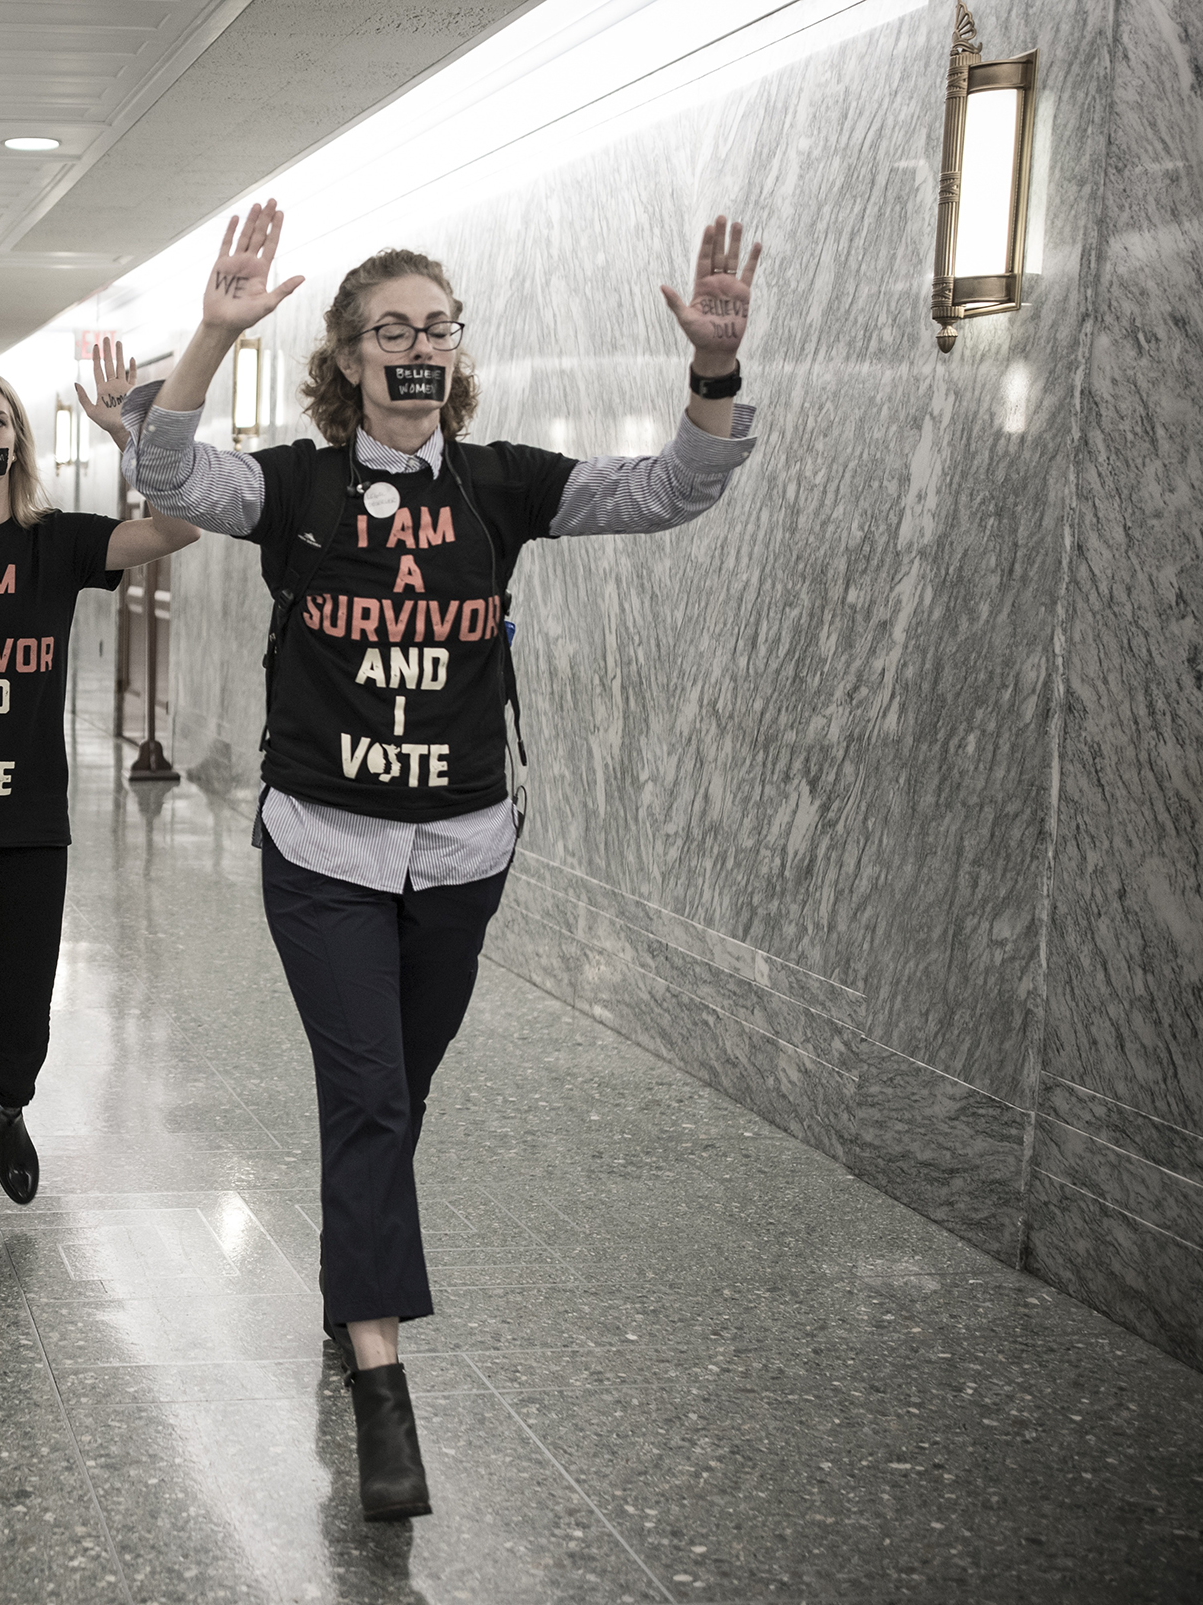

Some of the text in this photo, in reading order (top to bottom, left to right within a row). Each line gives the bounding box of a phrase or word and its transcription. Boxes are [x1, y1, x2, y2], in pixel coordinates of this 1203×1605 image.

[215, 270, 249, 299] WE
[700, 298, 748, 318] BELIEVE
[709, 320, 738, 339] YOU
[101, 393, 127, 409] Wom
[357, 506, 455, 549] I AM
[393, 554, 426, 593] A
[302, 593, 500, 643] SURVIVOR
[355, 647, 450, 690] AND
[393, 695, 406, 736] I
[341, 733, 450, 788] VOTE
